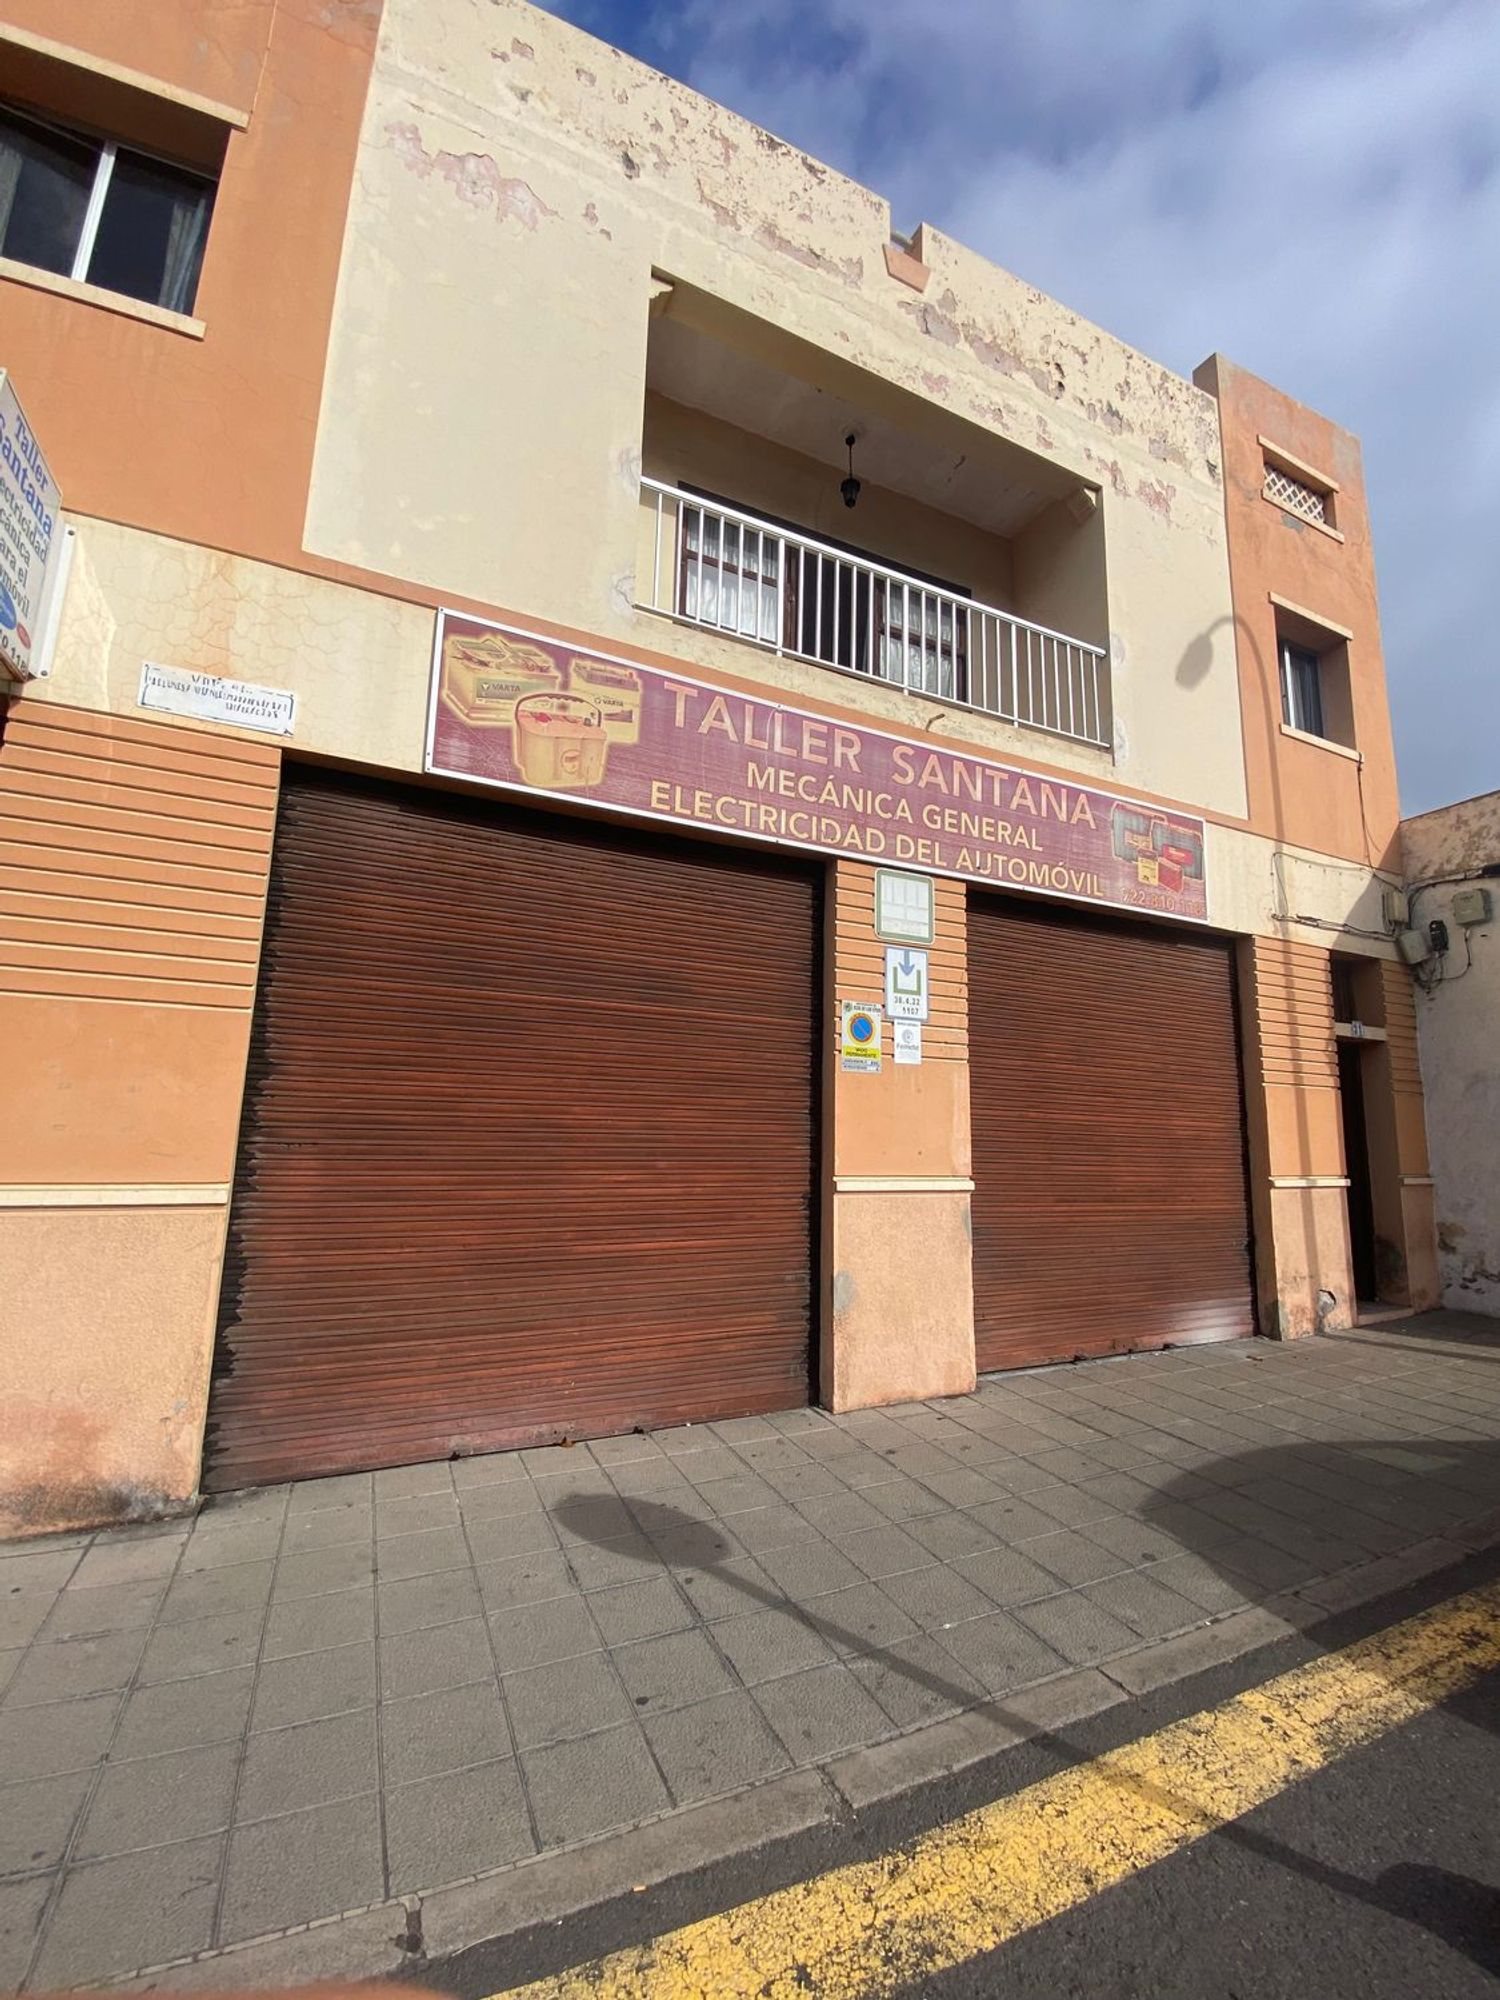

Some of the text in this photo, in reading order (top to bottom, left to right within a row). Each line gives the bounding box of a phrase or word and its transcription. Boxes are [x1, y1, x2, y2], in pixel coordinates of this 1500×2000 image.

[15, 414, 48, 492] Taller
[18, 565, 28, 588] el
[663, 681, 1097, 830] TALLER SANTANA
[650, 780, 886, 855] ELECTRICIDAD
[896, 834, 947, 867] DEL
[955, 845, 1105, 897] AUTOMÓVIL
[747, 762, 1044, 852] MECÁNICA GENERAL
